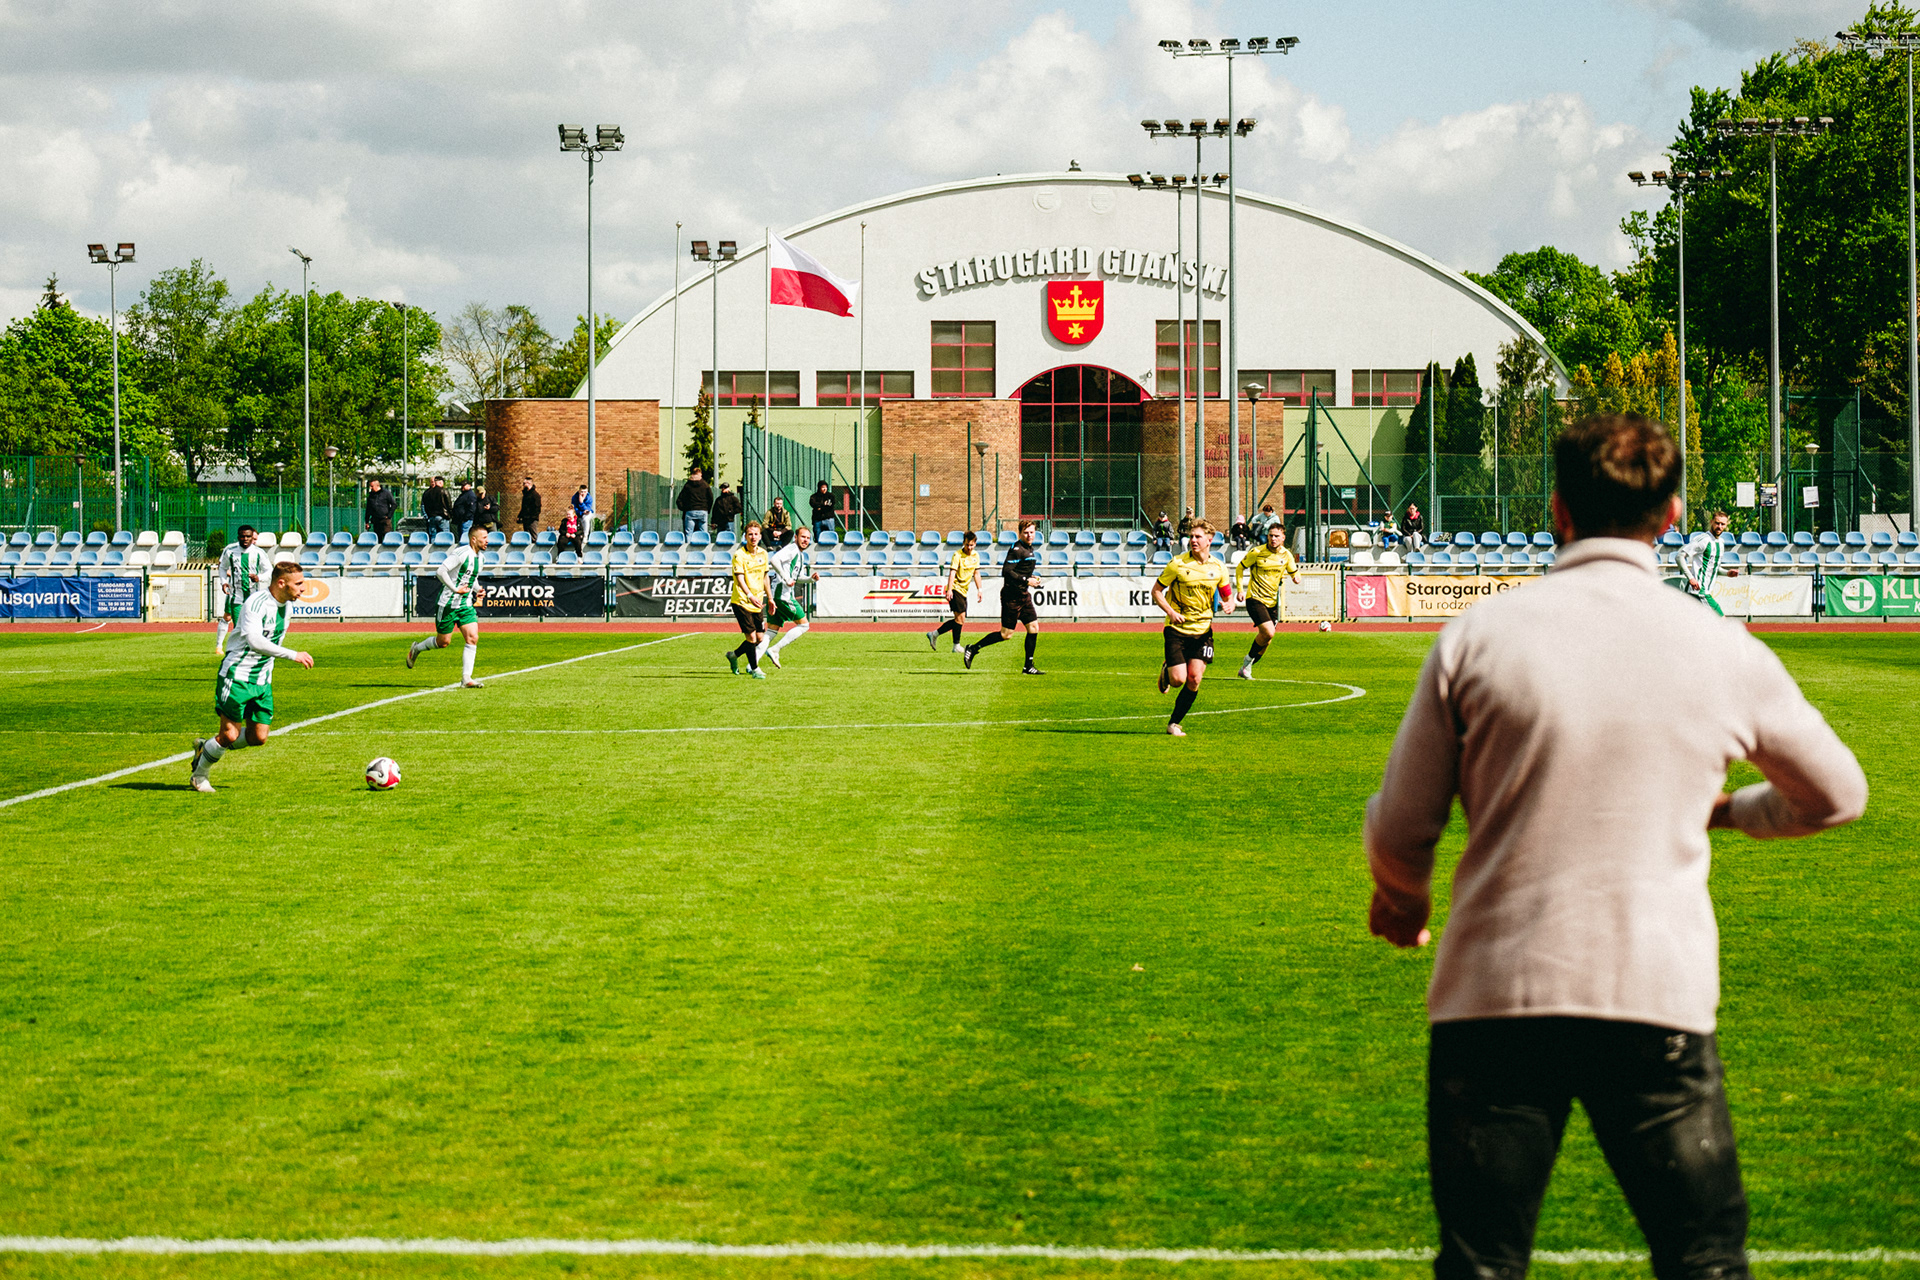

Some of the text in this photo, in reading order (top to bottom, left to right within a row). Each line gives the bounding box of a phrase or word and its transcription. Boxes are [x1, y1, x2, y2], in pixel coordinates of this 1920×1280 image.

[918, 245, 1095, 295] STAROGARD
[879, 578, 911, 590] BRO
[1406, 581, 1491, 599] Starogard
[486, 585, 555, 598] PANTOR
[1082, 590, 1126, 606] KING
[486, 599, 555, 607] DRZWI NA LATA
[1418, 600, 1433, 610] Tu
[1203, 645, 1214, 658] 10
